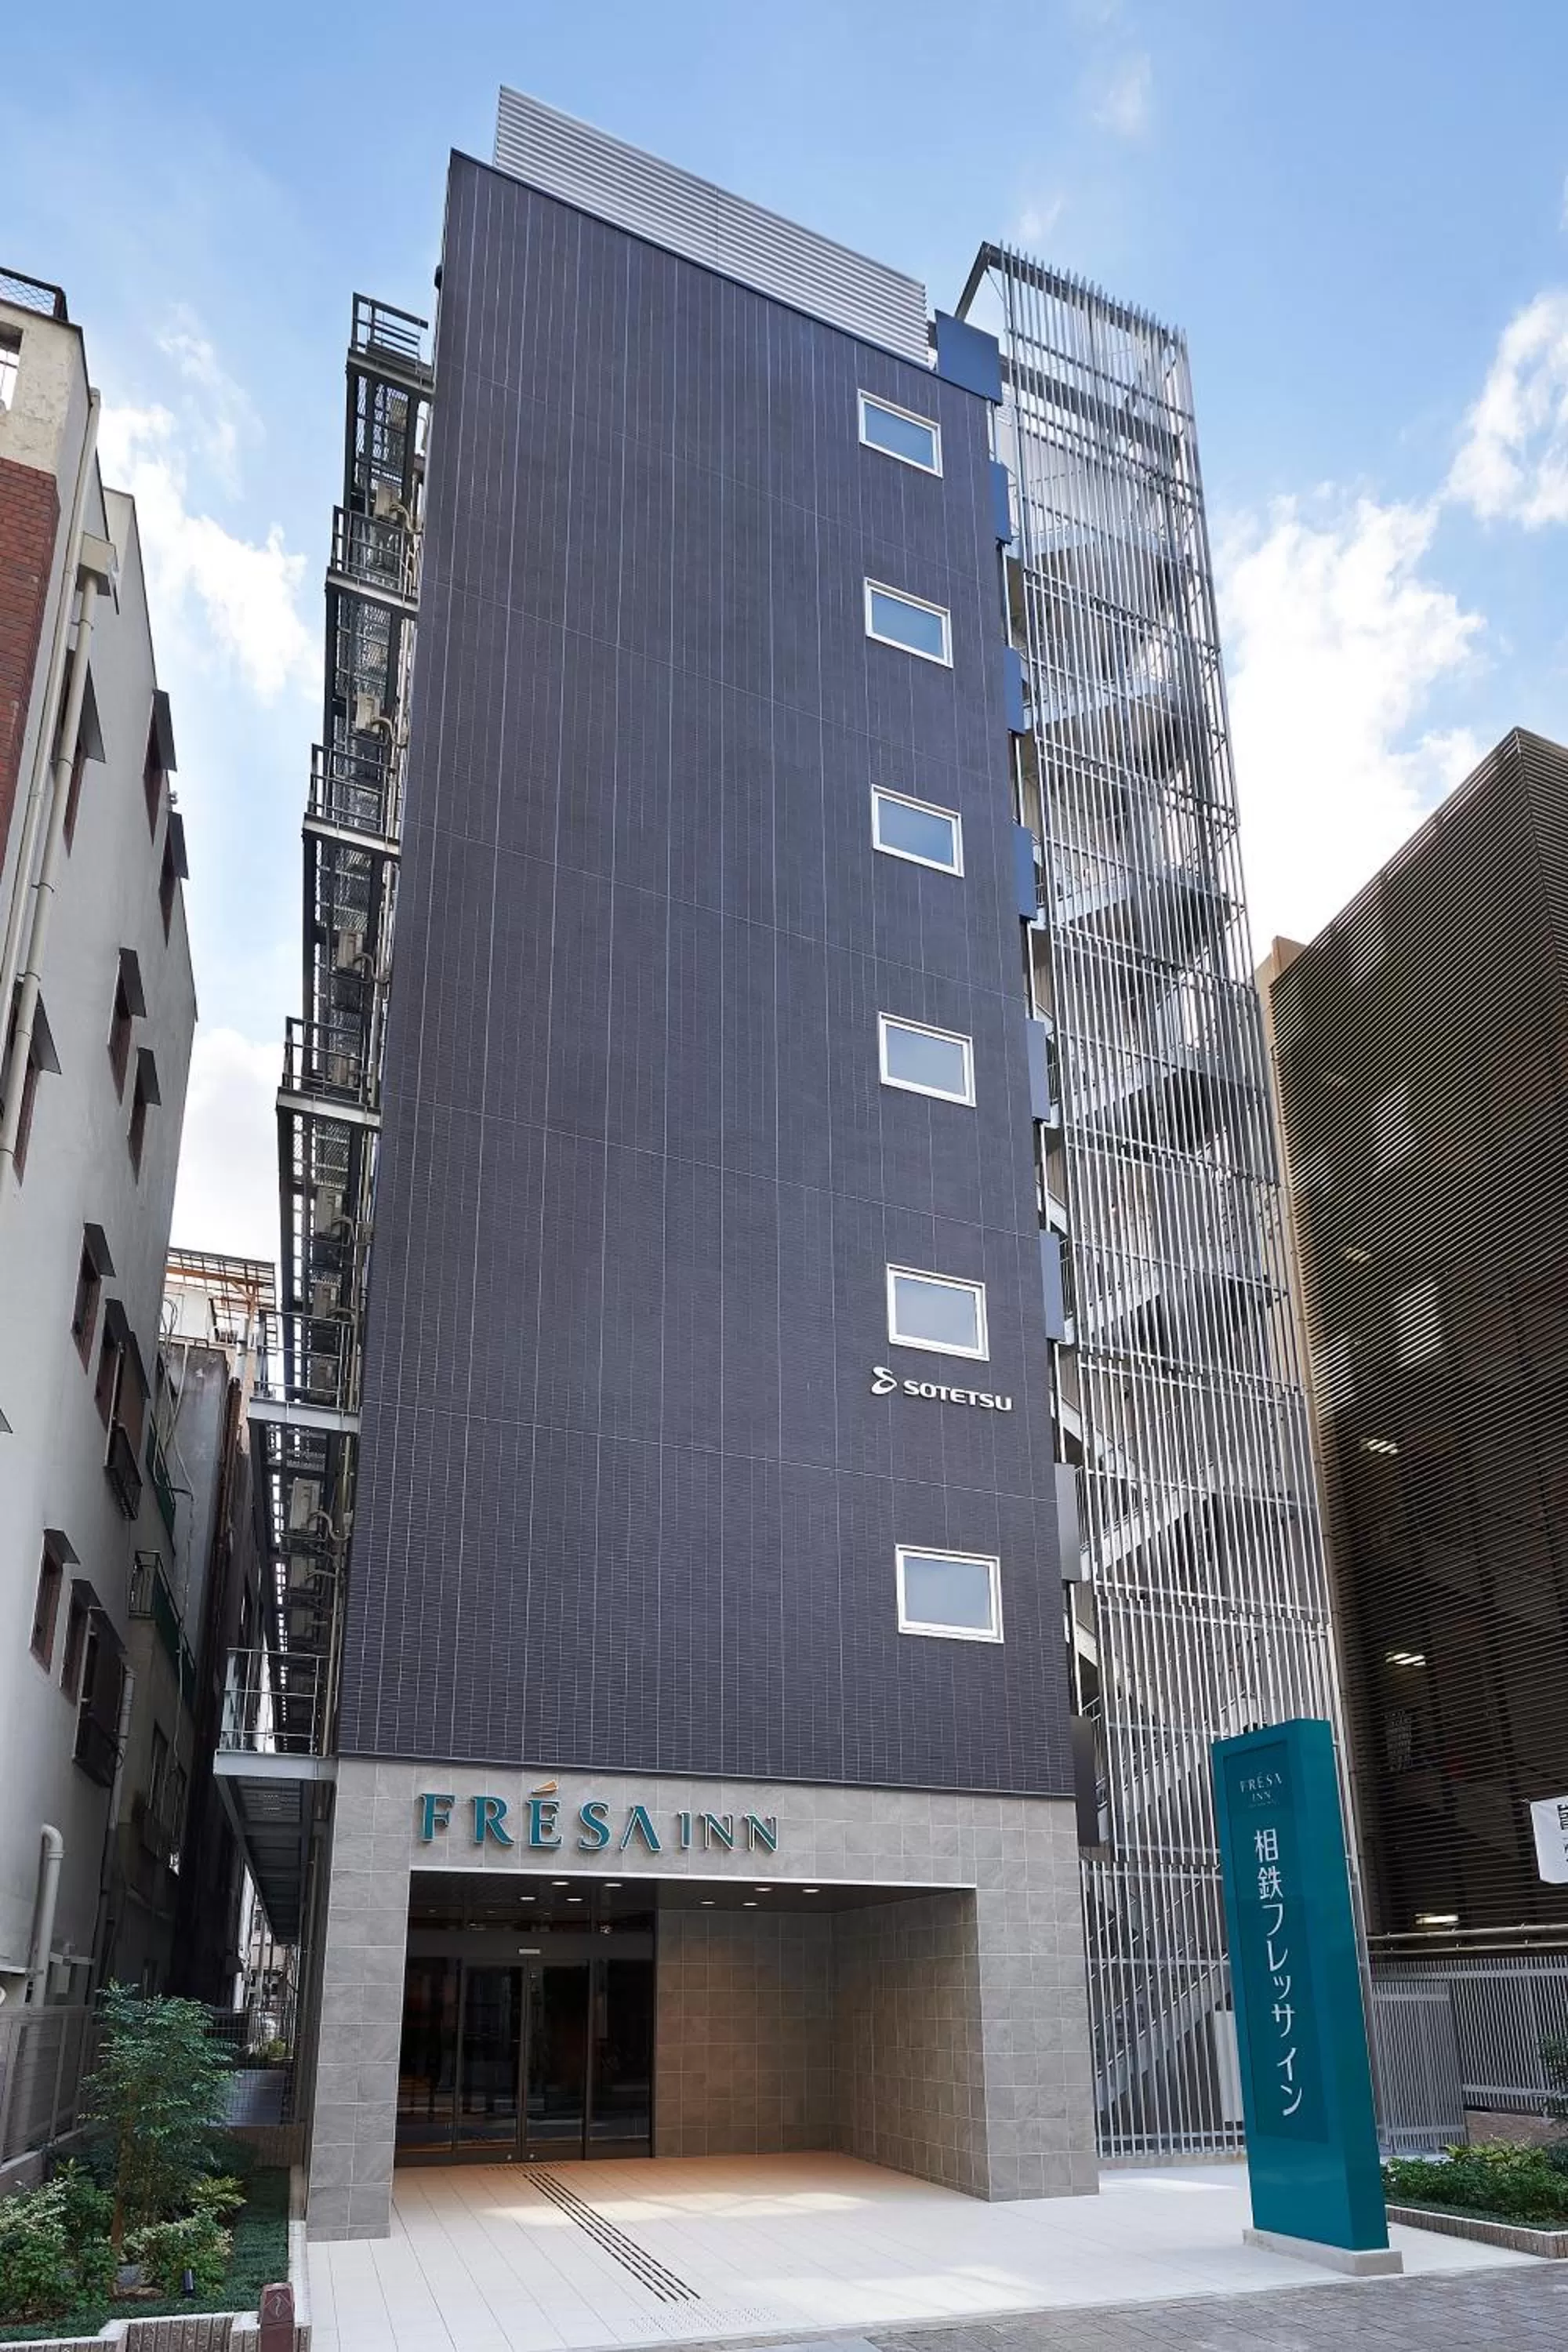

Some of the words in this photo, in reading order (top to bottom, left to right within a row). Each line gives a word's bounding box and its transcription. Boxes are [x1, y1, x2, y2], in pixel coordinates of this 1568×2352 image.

[903, 1379, 1012, 1411] SOTETSU
[419, 1780, 662, 1853] FRÉSA
[677, 1809, 779, 1853] INN
[1252, 1791, 1271, 1802] INN
[1254, 1828, 1303, 2116] 相鉄フレッサイン
